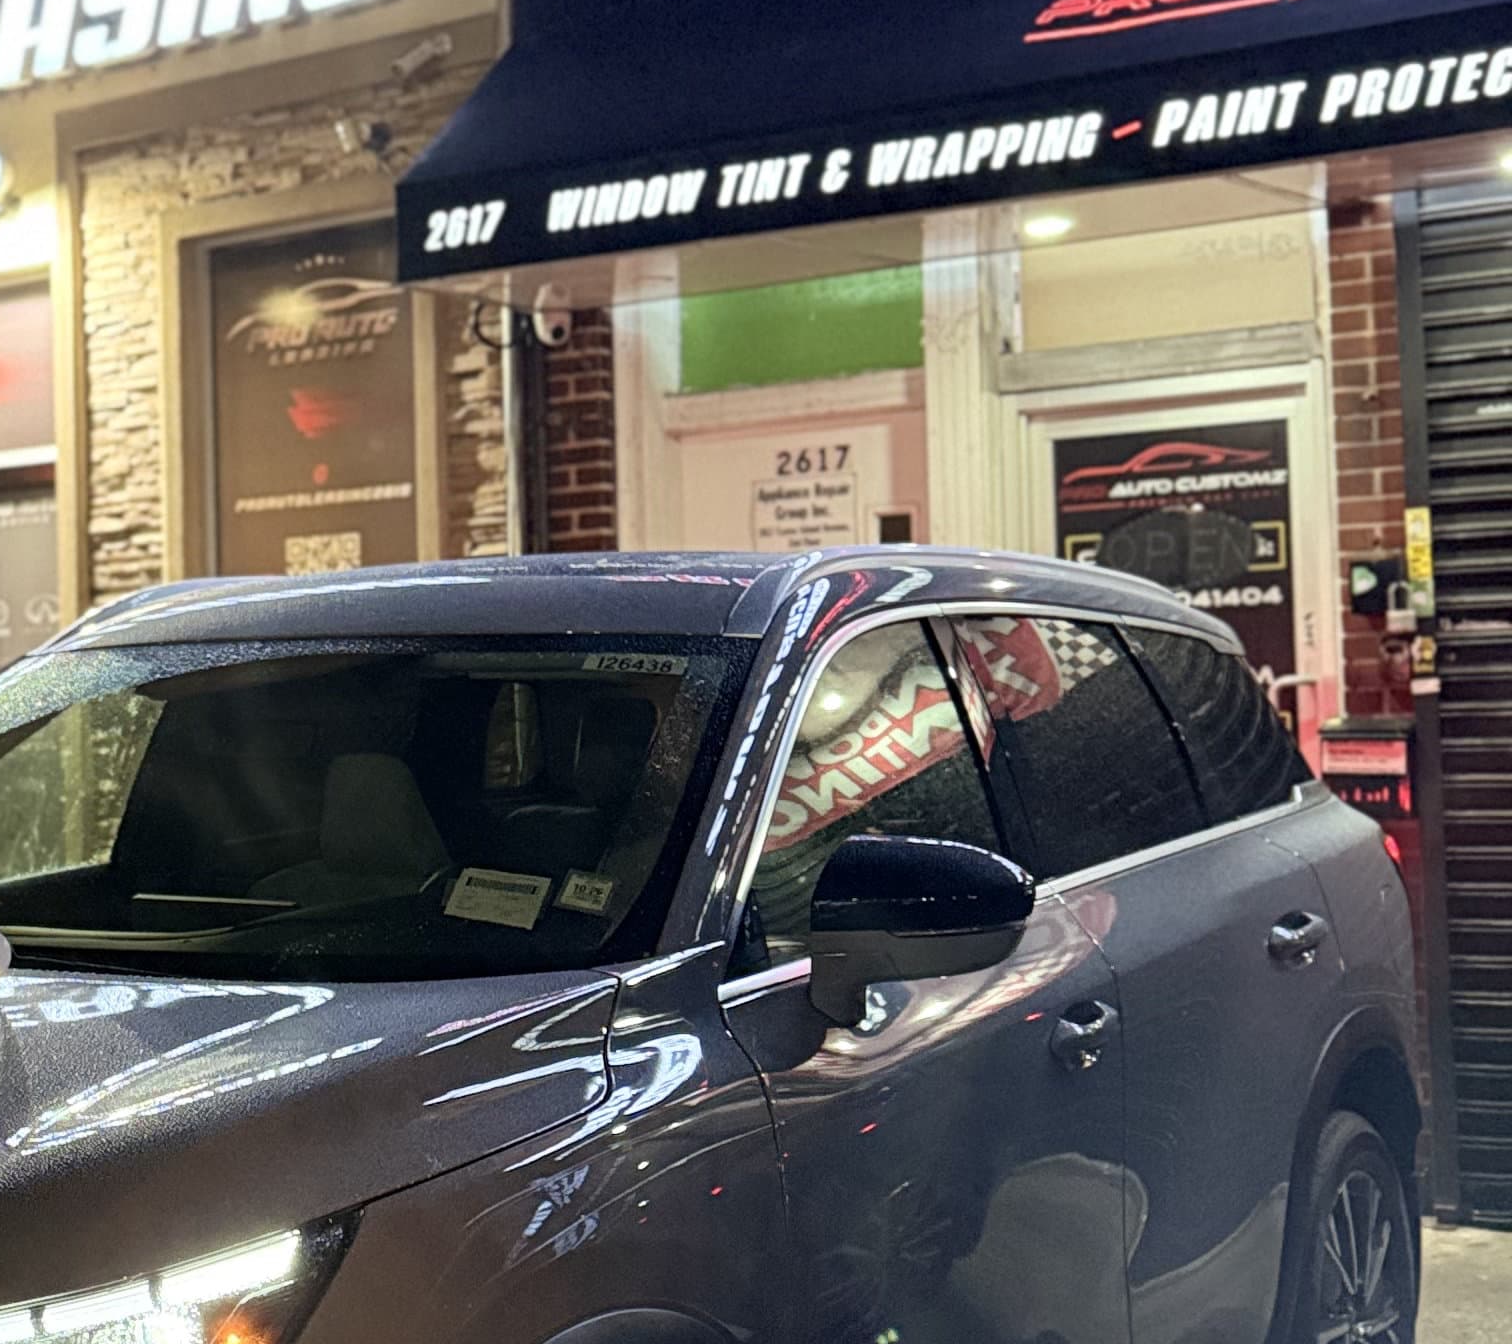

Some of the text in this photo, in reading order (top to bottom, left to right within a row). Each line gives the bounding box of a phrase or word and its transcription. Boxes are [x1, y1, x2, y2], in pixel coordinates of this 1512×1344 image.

[424, 200, 507, 252] 2617
[546, 168, 707, 233] WINDOW
[716, 153, 812, 209] TINT
[820, 149, 853, 195] &
[866, 111, 1104, 188] WRAPPING
[1152, 80, 1307, 149] PAINT
[1319, 45, 1512, 125] PROTEC
[776, 443, 851, 477] 2617
[1107, 477, 1173, 499] AUTO
[1174, 467, 1288, 492] CUSTOMZ
[1107, 528, 1252, 571] OPEN
[596, 655, 674, 674] 126438
